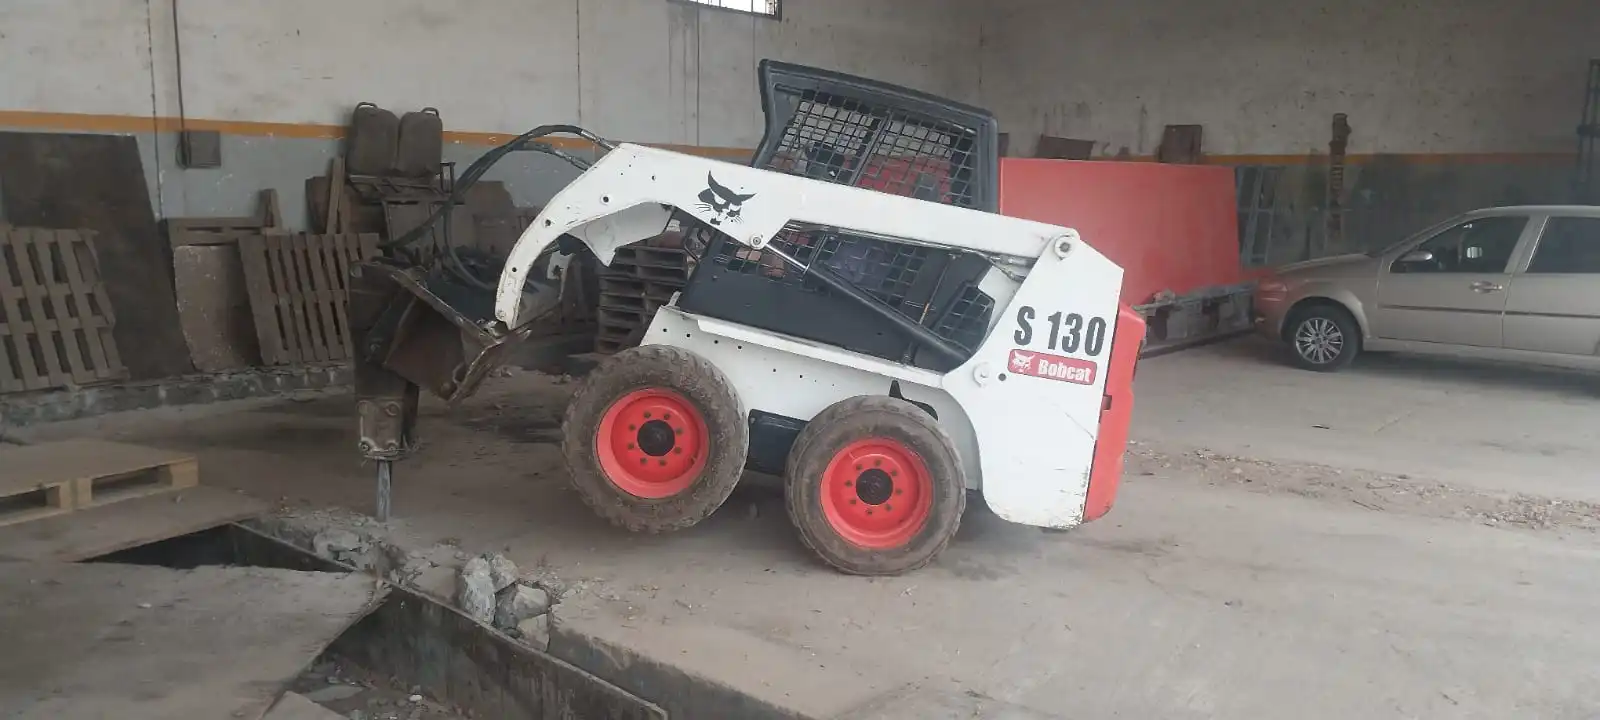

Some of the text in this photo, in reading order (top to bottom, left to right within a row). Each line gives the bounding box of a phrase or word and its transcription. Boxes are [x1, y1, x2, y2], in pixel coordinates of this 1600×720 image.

[1014, 306, 1106, 356] S 130
[1038, 358, 1091, 382] Bobcat
